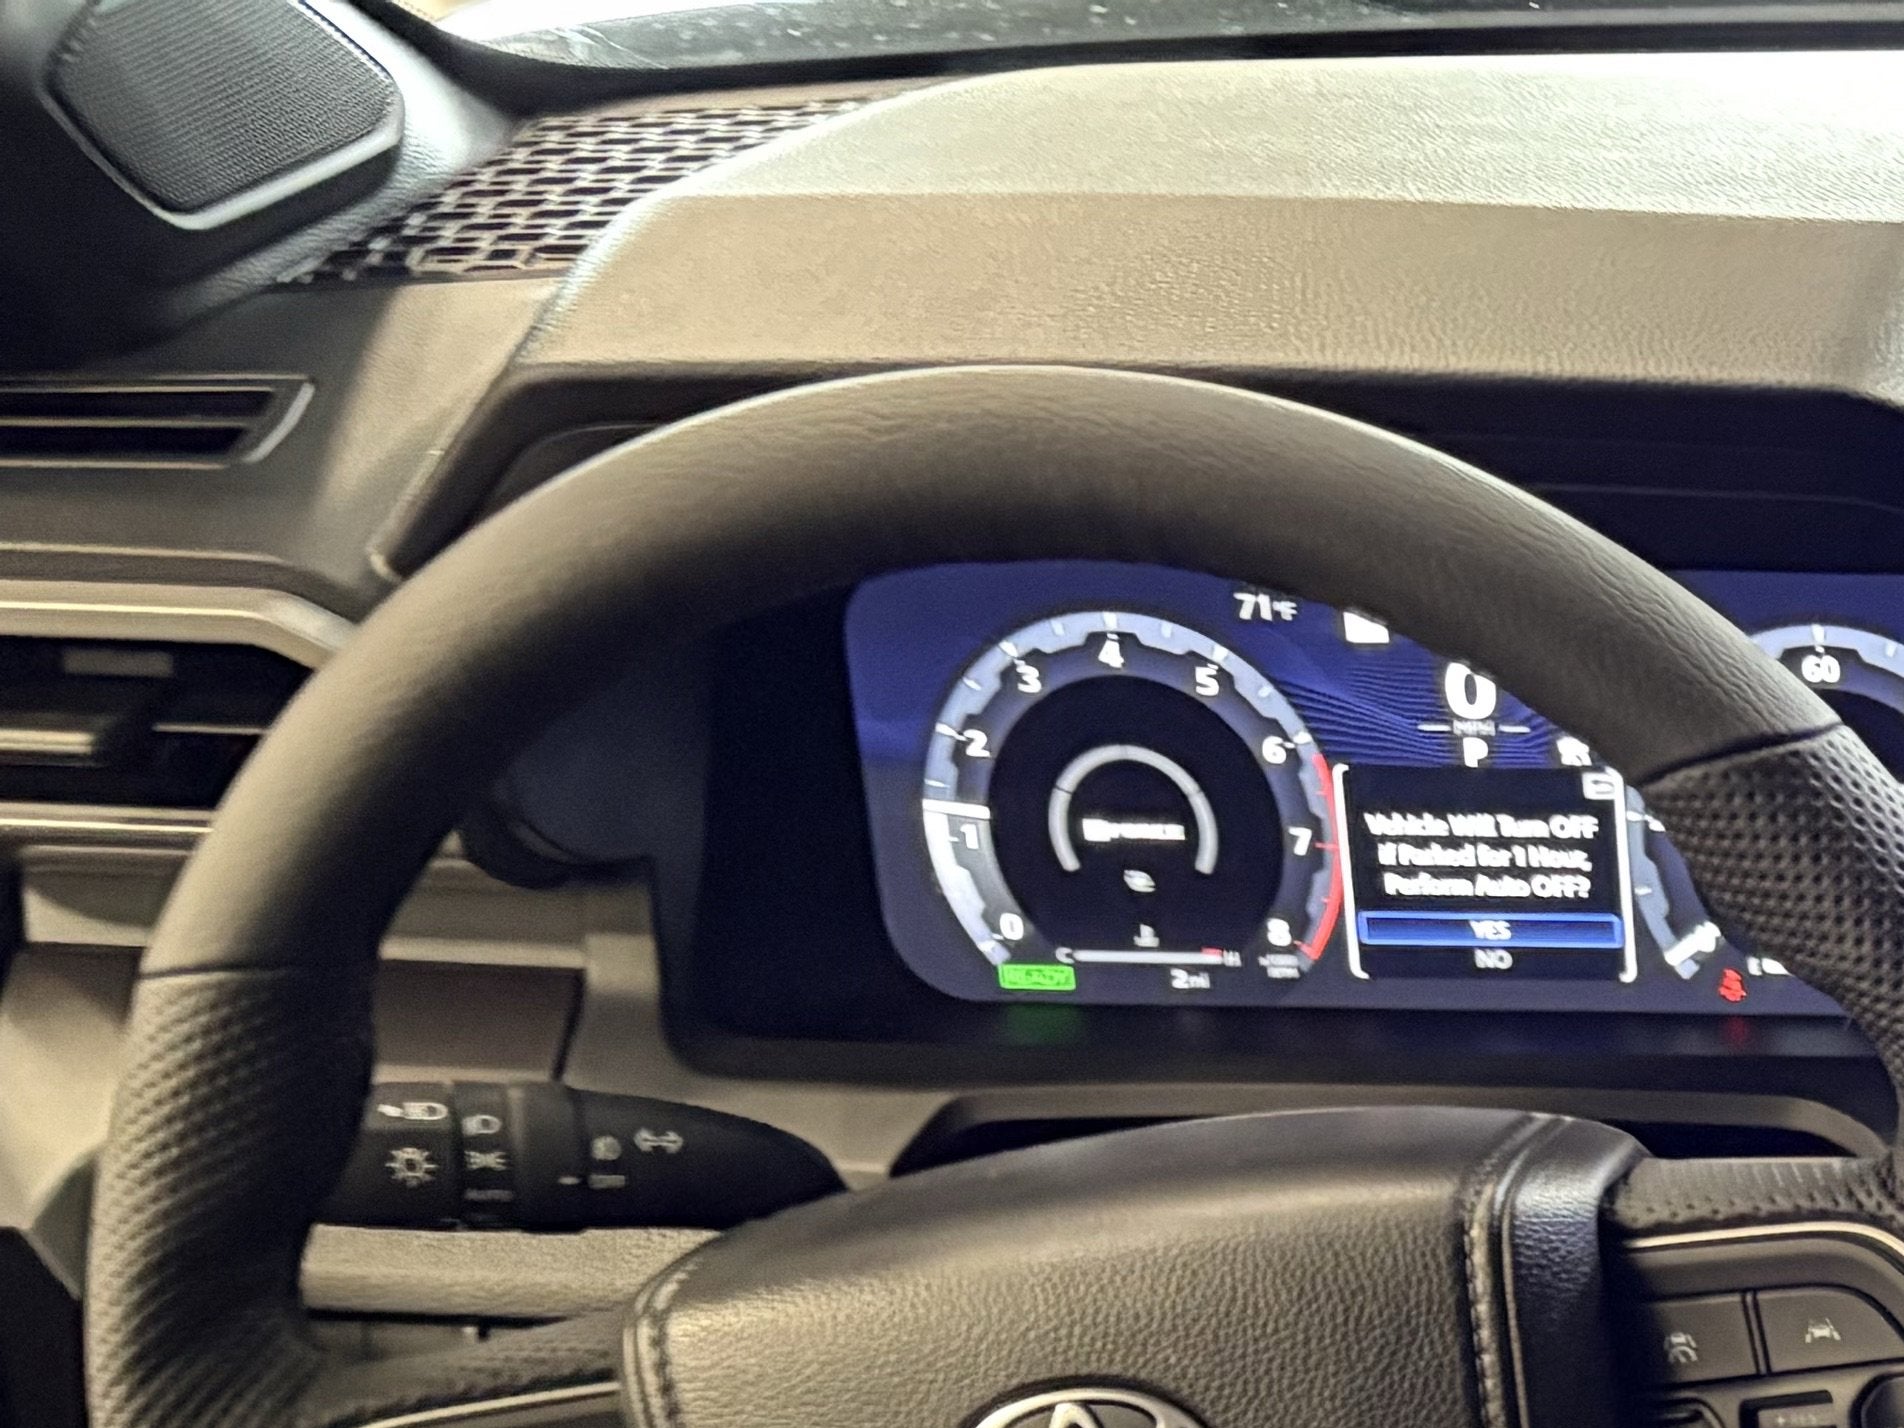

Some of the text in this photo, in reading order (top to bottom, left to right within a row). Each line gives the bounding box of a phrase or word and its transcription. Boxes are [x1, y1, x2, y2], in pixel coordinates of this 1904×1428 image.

[1099, 638, 1124, 668] 4
[1017, 665, 1042, 693] 3
[1195, 668, 1219, 696] 5
[1801, 655, 1841, 684] 60
[963, 731, 990, 757] 2
[1262, 736, 1286, 763] 6
[1463, 737, 1489, 768] P
[959, 824, 979, 850] 1
[1549, 815, 1599, 839] OFF
[1289, 828, 1312, 855] 7
[1530, 874, 1592, 899] OFF?
[1000, 912, 1024, 940] 0
[1267, 918, 1292, 946] 8
[1470, 920, 1512, 940] YES
[1474, 949, 1514, 969] NO
